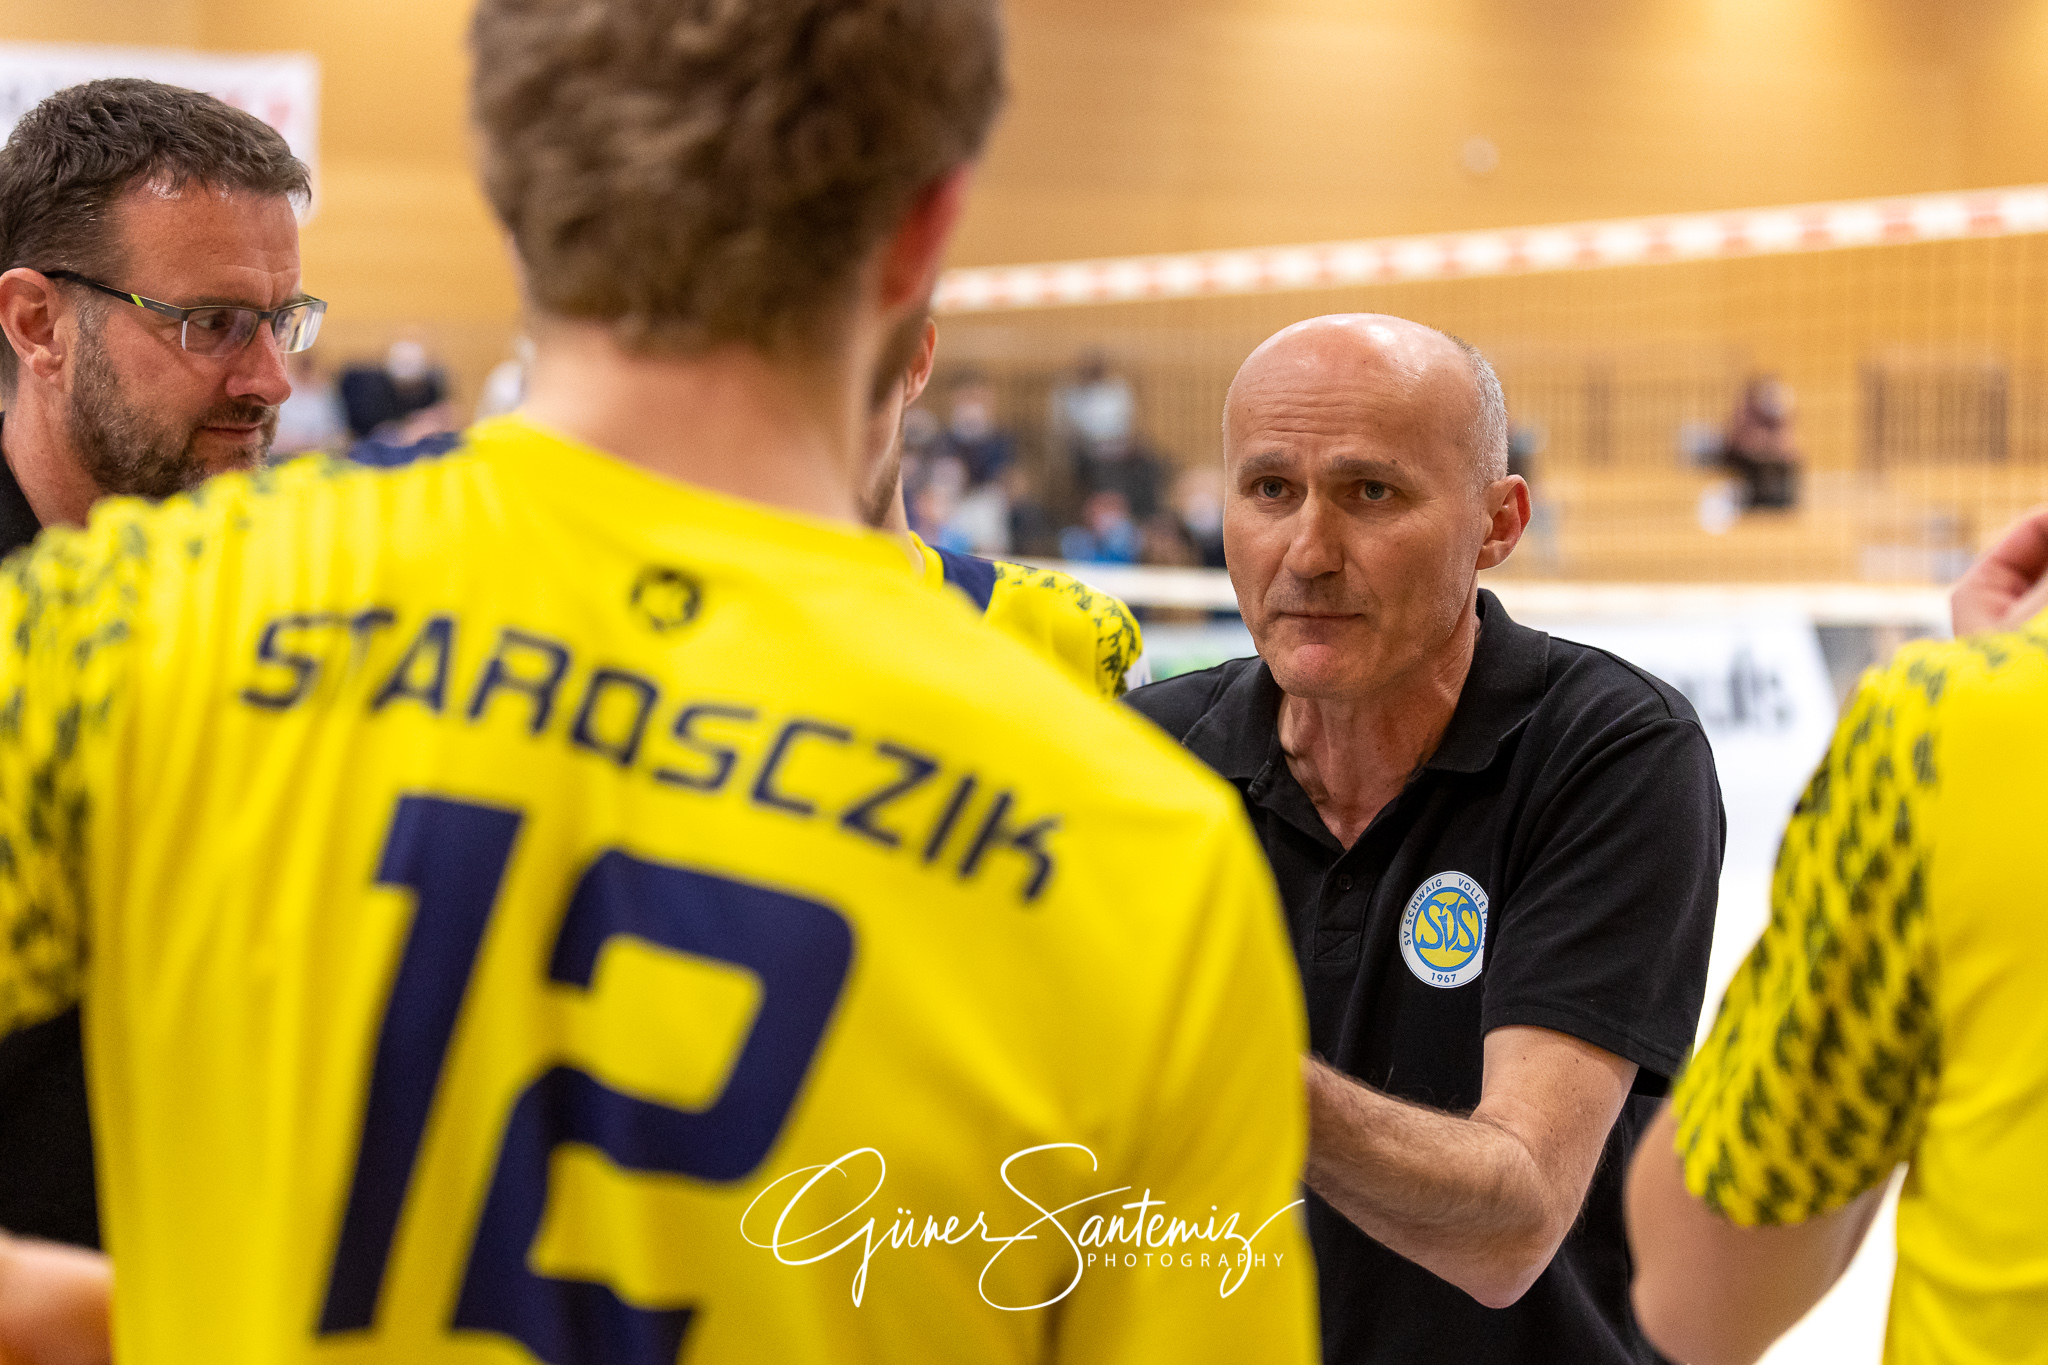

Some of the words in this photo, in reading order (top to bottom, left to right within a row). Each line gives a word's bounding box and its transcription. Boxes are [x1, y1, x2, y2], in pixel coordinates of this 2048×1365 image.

[240, 608, 1062, 904] STAROSCZIK
[1405, 878, 1442, 926] SCHWAIG
[1403, 930, 1411, 946] SV
[1431, 972, 1457, 984] 1967
[314, 792, 857, 1365] 12
